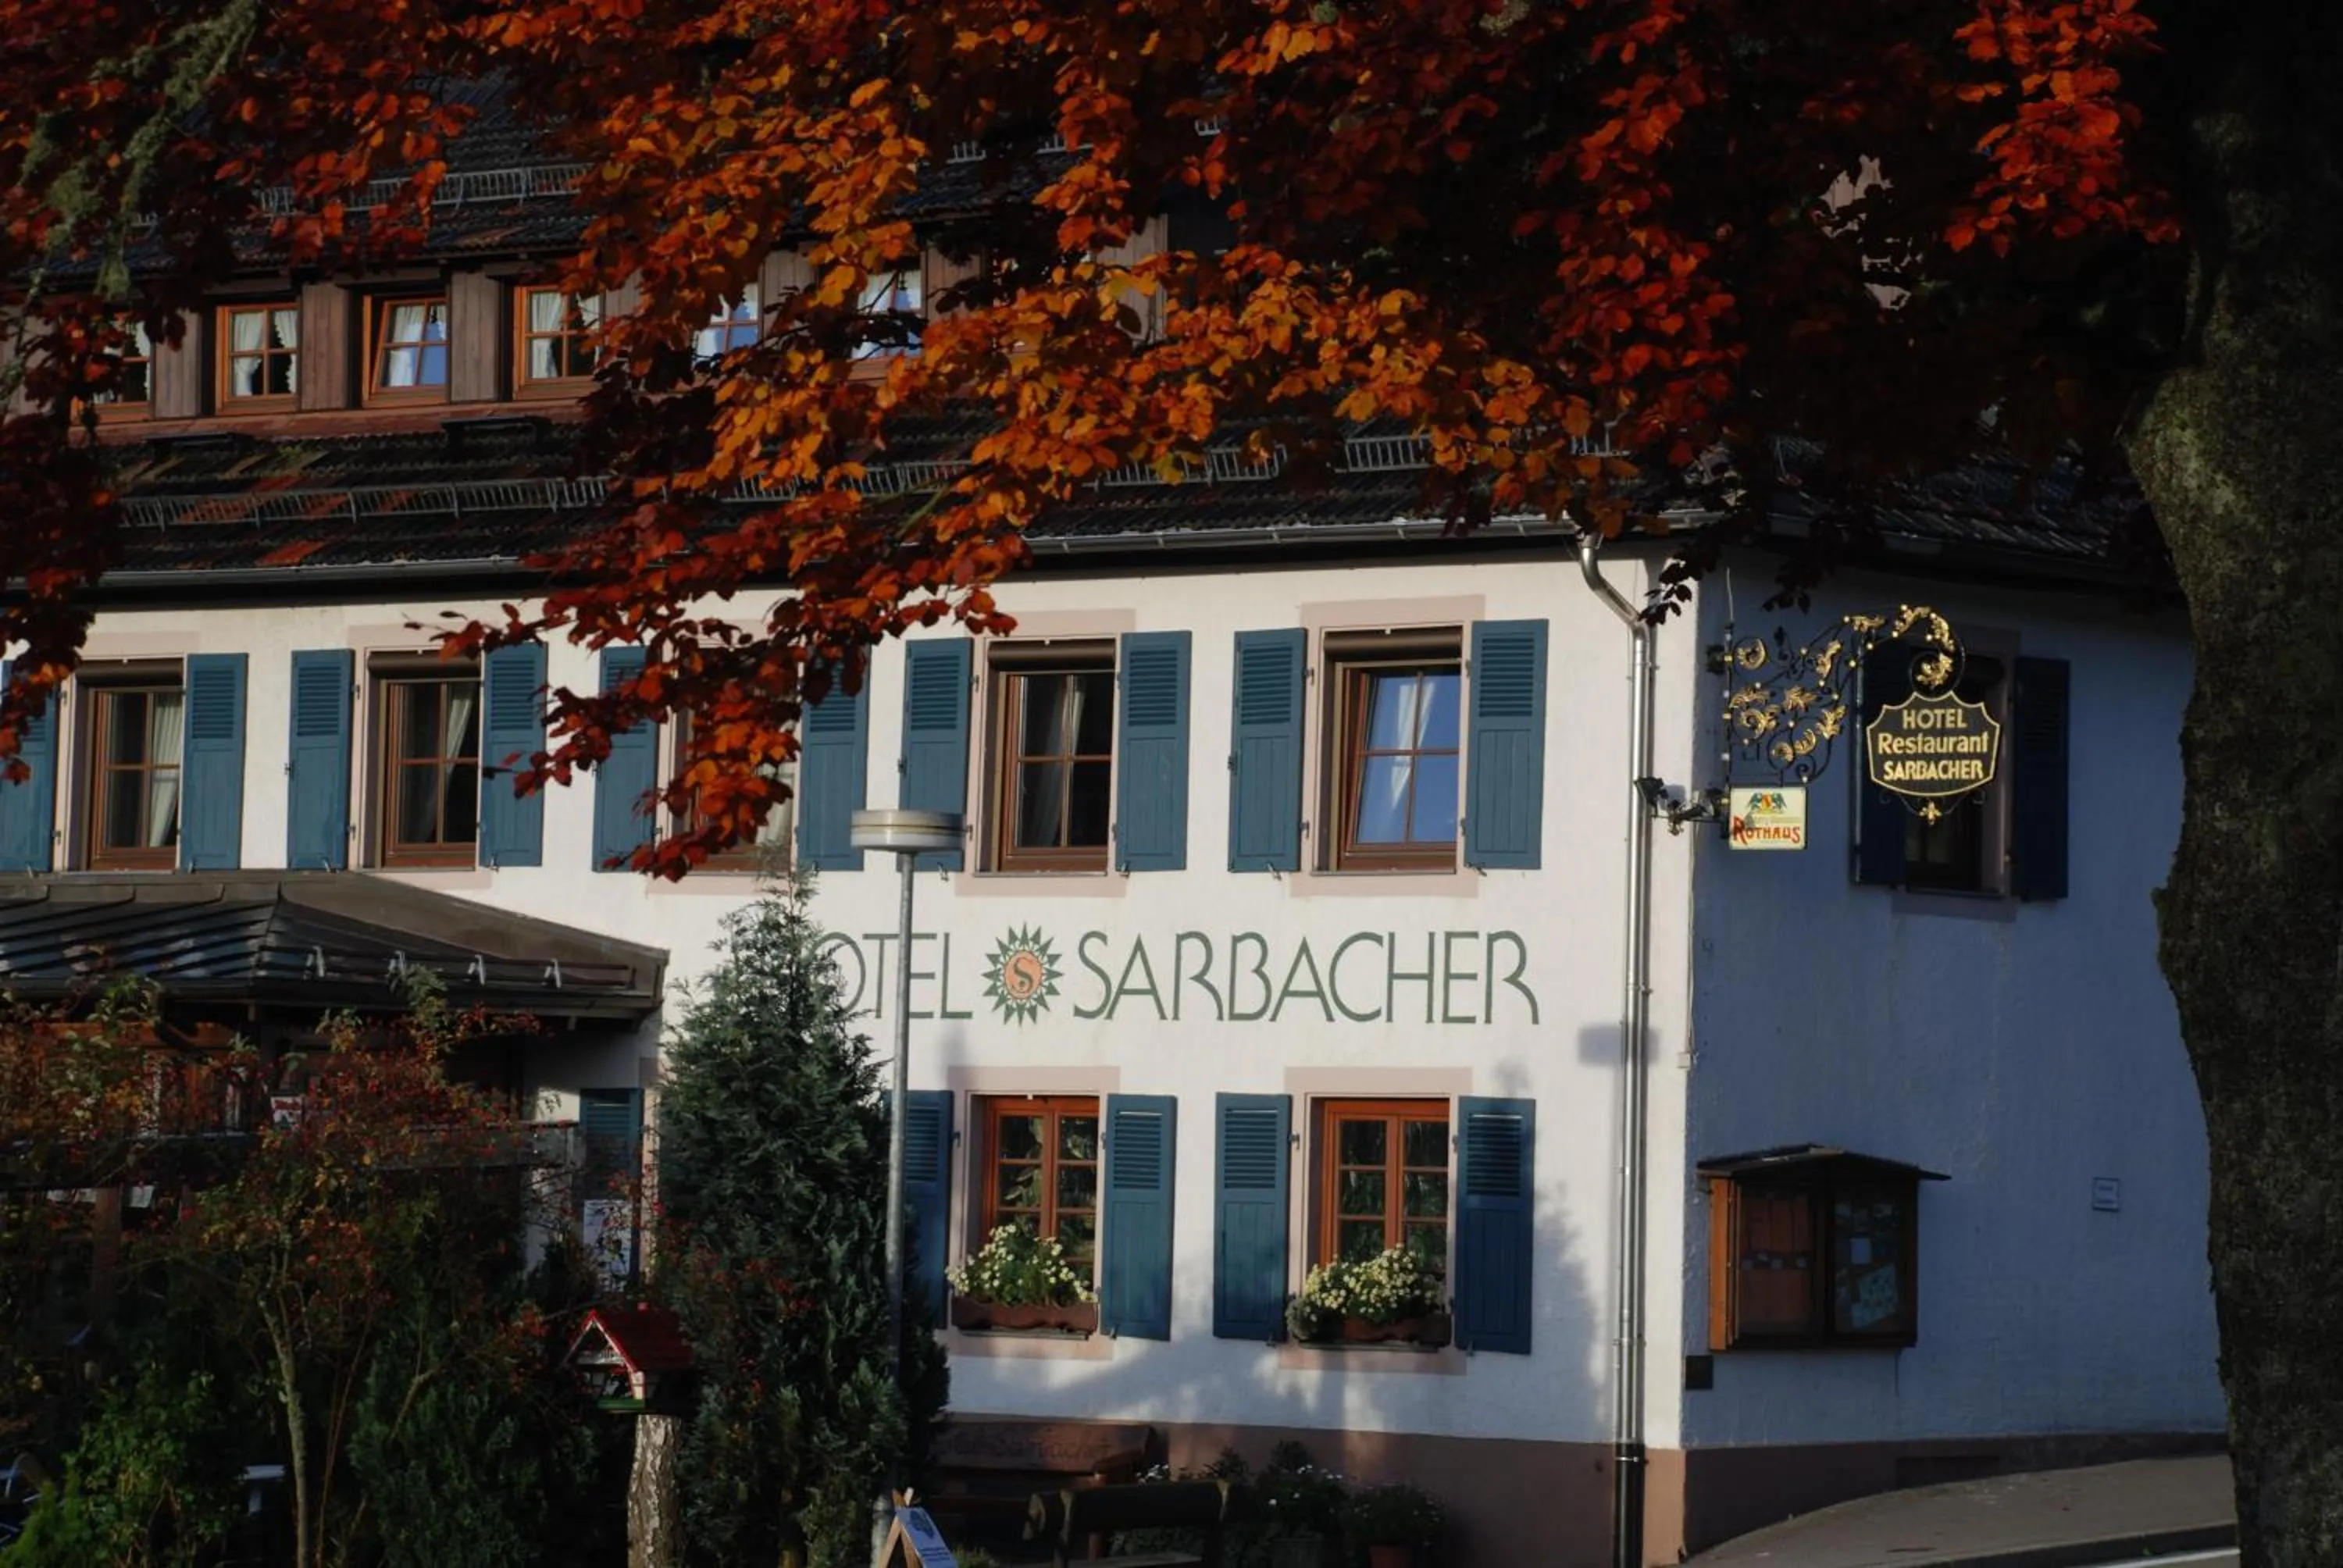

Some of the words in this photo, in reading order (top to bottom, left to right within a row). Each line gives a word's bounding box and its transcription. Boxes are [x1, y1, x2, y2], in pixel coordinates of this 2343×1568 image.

[1902, 708, 1967, 729] HOTEL
[1878, 731, 1988, 755] Restaurant
[1883, 759, 1984, 781] SARBACHER
[814, 932, 973, 1020] OTEL
[1073, 930, 1540, 1025] SARBACHER
